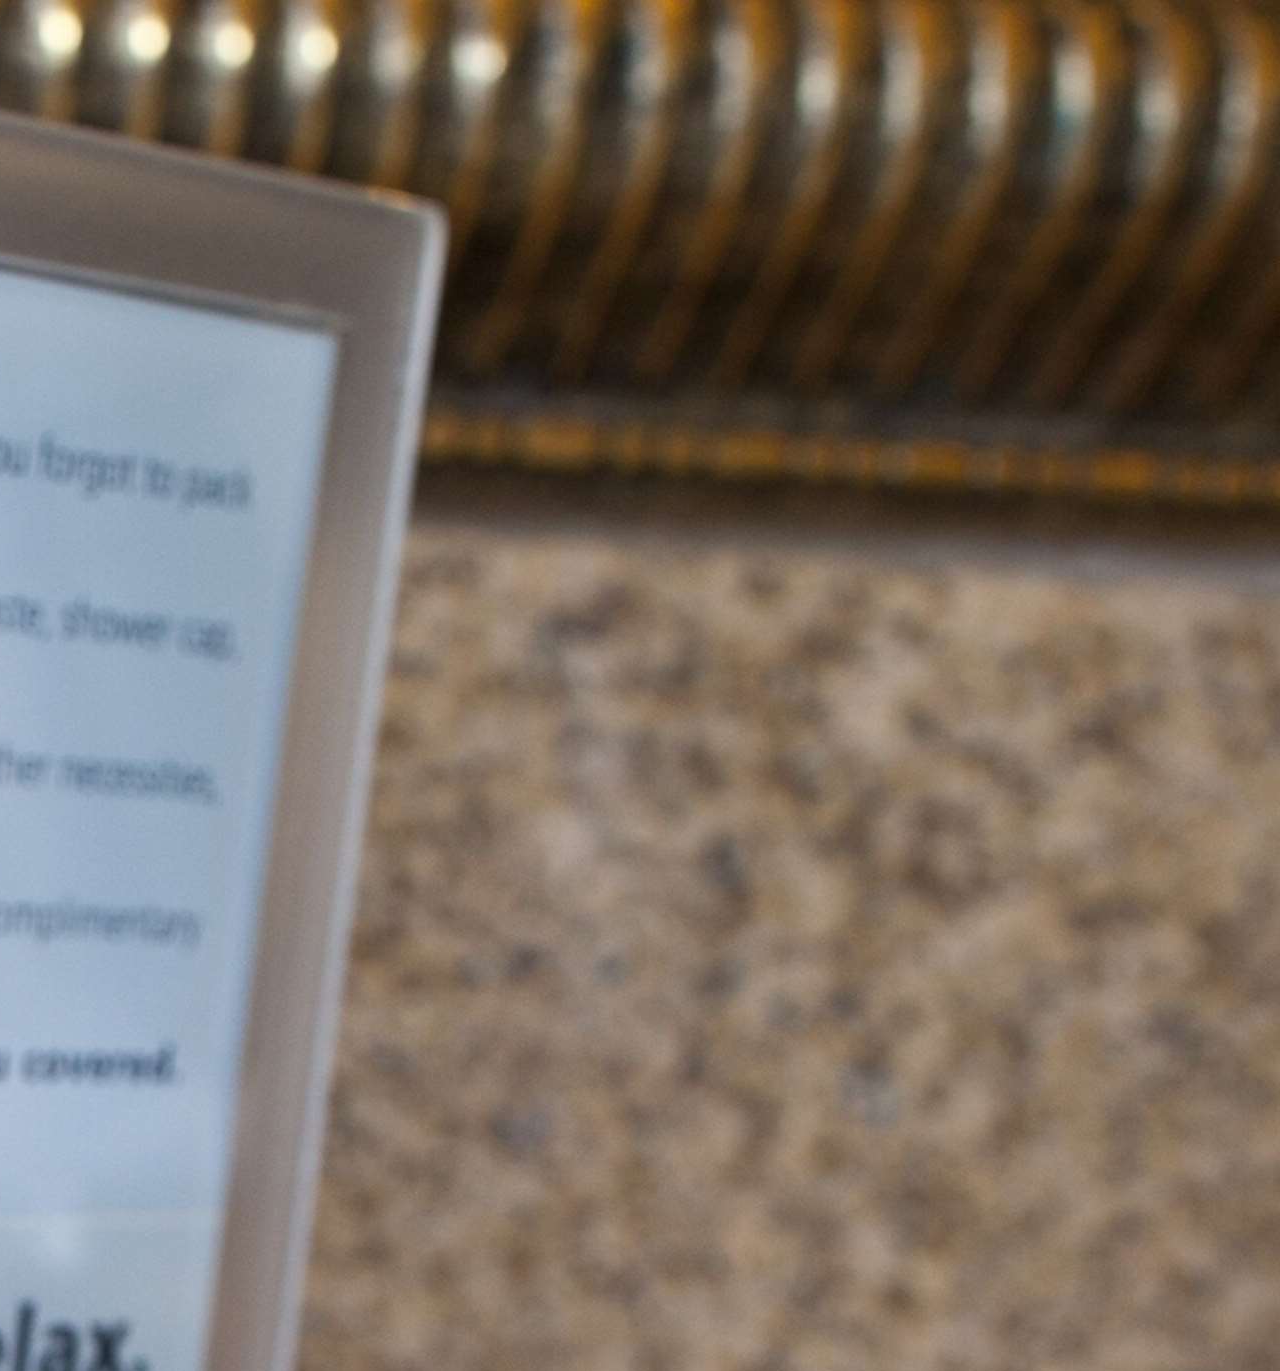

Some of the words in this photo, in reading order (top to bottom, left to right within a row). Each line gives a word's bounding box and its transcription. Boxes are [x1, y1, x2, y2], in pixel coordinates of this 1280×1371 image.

[38, 428, 137, 501] forgot
[59, 592, 169, 648] shower
[18, 1038, 183, 1086] covered.
